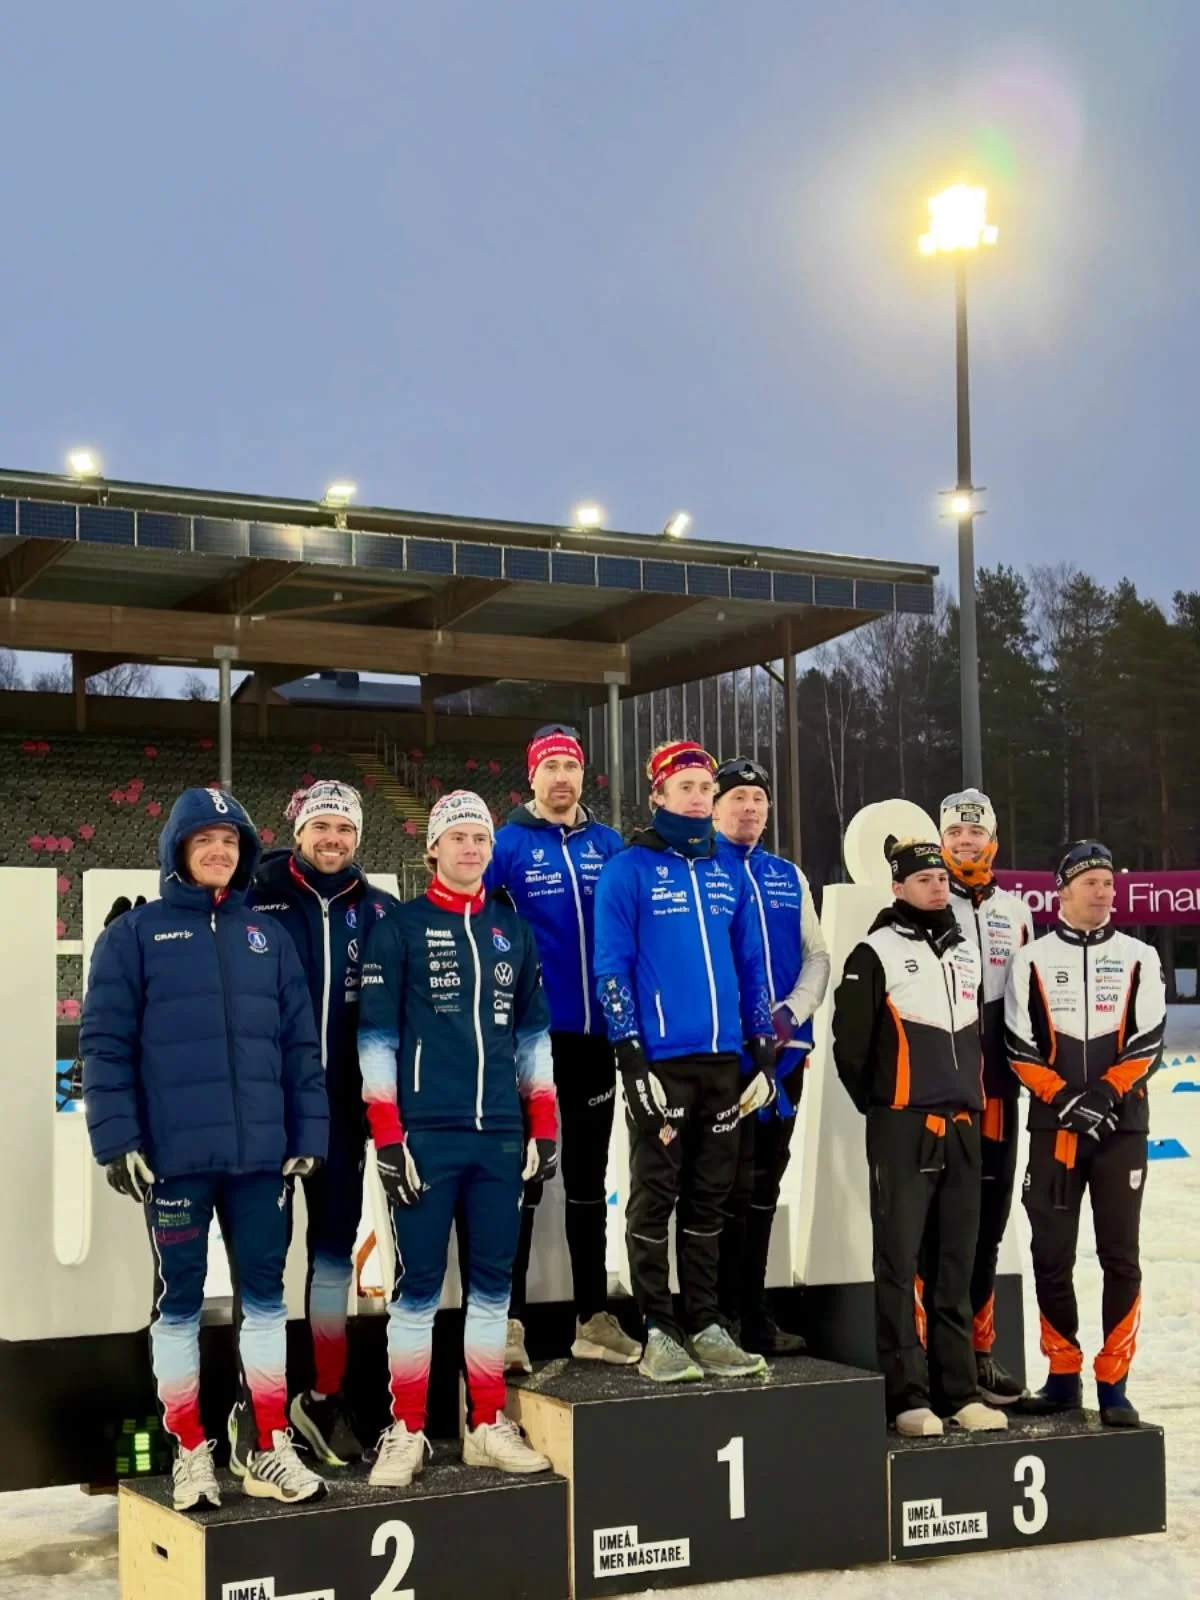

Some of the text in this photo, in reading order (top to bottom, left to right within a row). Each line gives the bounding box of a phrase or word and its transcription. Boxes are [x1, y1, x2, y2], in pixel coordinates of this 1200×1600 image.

[154, 933, 184, 941] CRAFT
[717, 1436, 745, 1519] 1
[1013, 1455, 1048, 1534] 3
[908, 1503, 940, 1521] UMEÅ.
[599, 1529, 635, 1551] UMEÅ.
[909, 1519, 983, 1539] MER MÄSTARE.
[371, 1520, 415, 1600] 2
[600, 1546, 685, 1571] MER MÄSTARE.
